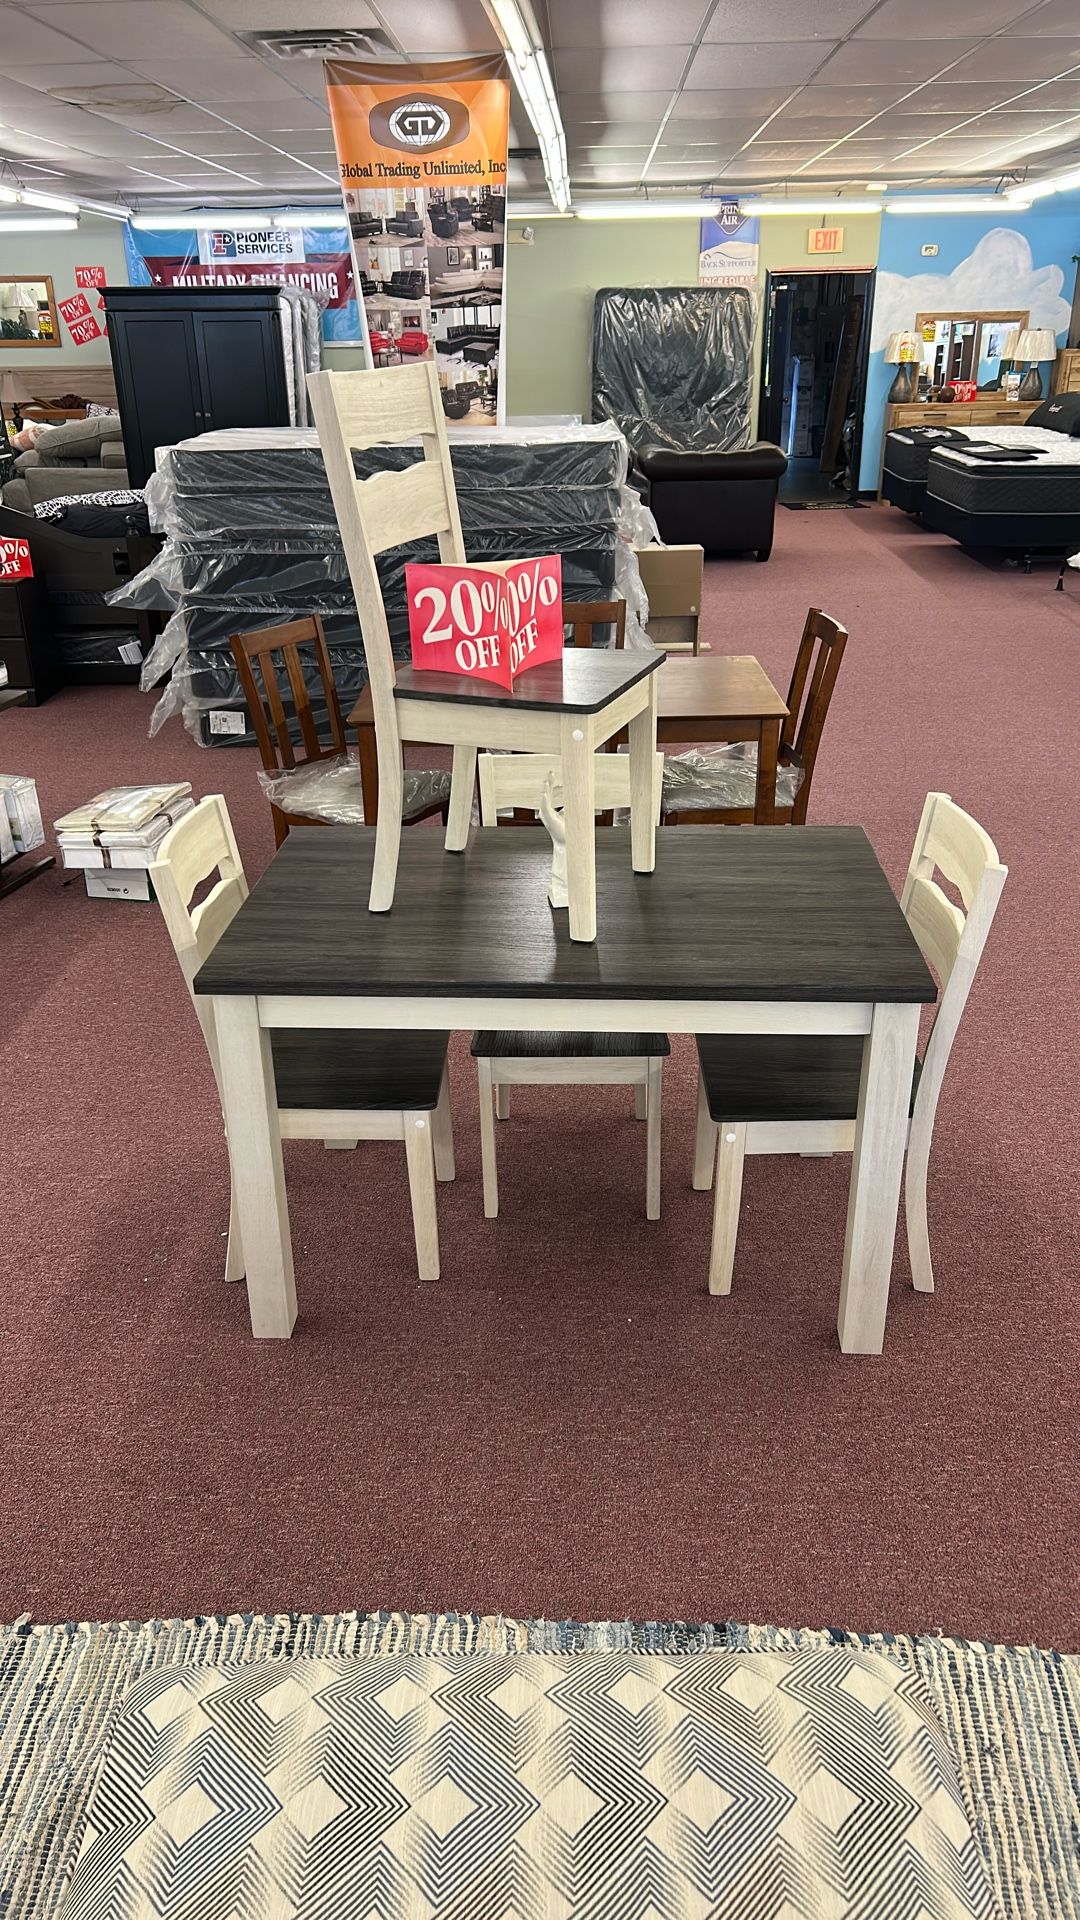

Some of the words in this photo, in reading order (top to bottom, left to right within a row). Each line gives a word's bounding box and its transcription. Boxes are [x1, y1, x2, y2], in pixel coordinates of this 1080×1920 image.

[375, 163, 420, 179] Trading
[424, 160, 485, 176] Unlimited,
[720, 215, 738, 225] AIR
[237, 232, 291, 243] PIONEER
[815, 230, 838, 250] EXIT
[237, 244, 293, 254] SERVICES
[77, 268, 102, 282] 70%
[86, 280, 98, 288] OFF
[61, 296, 84, 318] 70%
[72, 320, 94, 340] 70%
[414, 578, 508, 644] 20%
[455, 634, 500, 671] OFF
[510, 618, 538, 673] OFF
